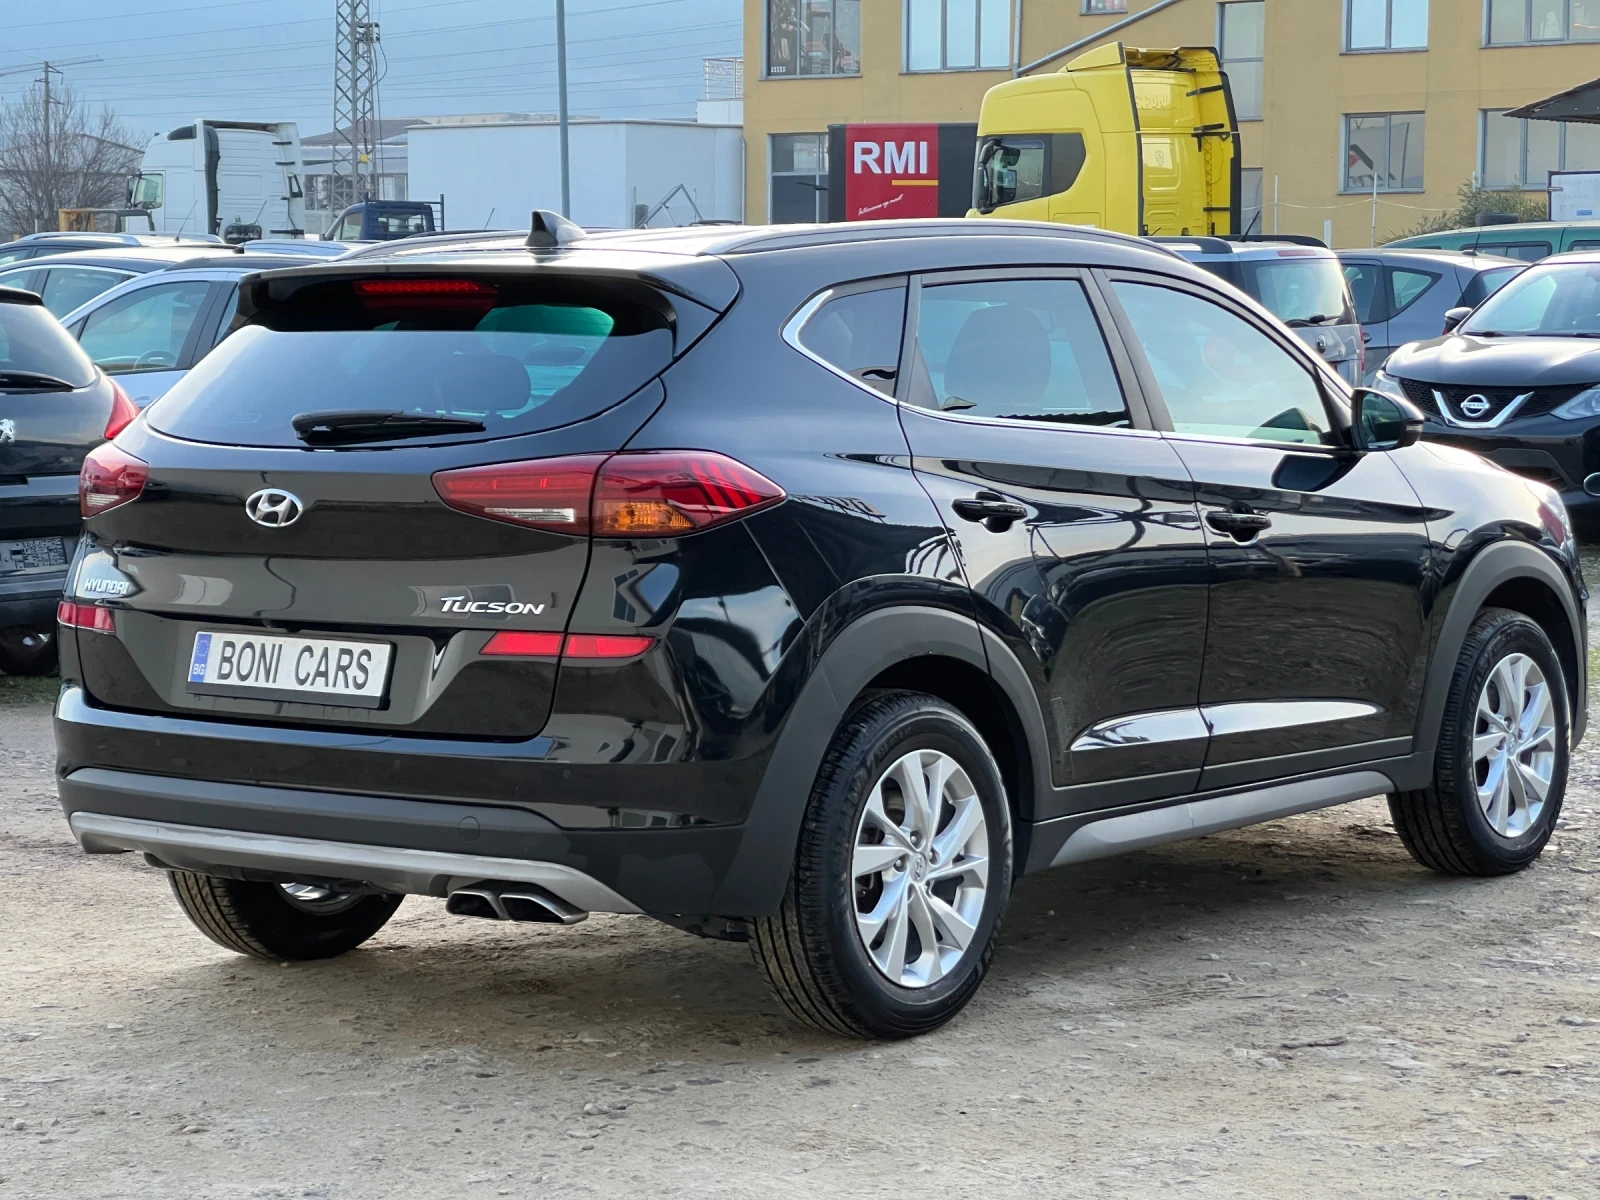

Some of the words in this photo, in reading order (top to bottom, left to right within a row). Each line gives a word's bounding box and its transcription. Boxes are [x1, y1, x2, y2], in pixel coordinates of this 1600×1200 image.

[853, 141, 928, 174] RMI
[84, 578, 129, 595] HYUNDAI
[440, 596, 545, 615] TUCSON
[192, 663, 206, 676] BG
[216, 640, 283, 684] BONI
[294, 645, 372, 691] CARS
